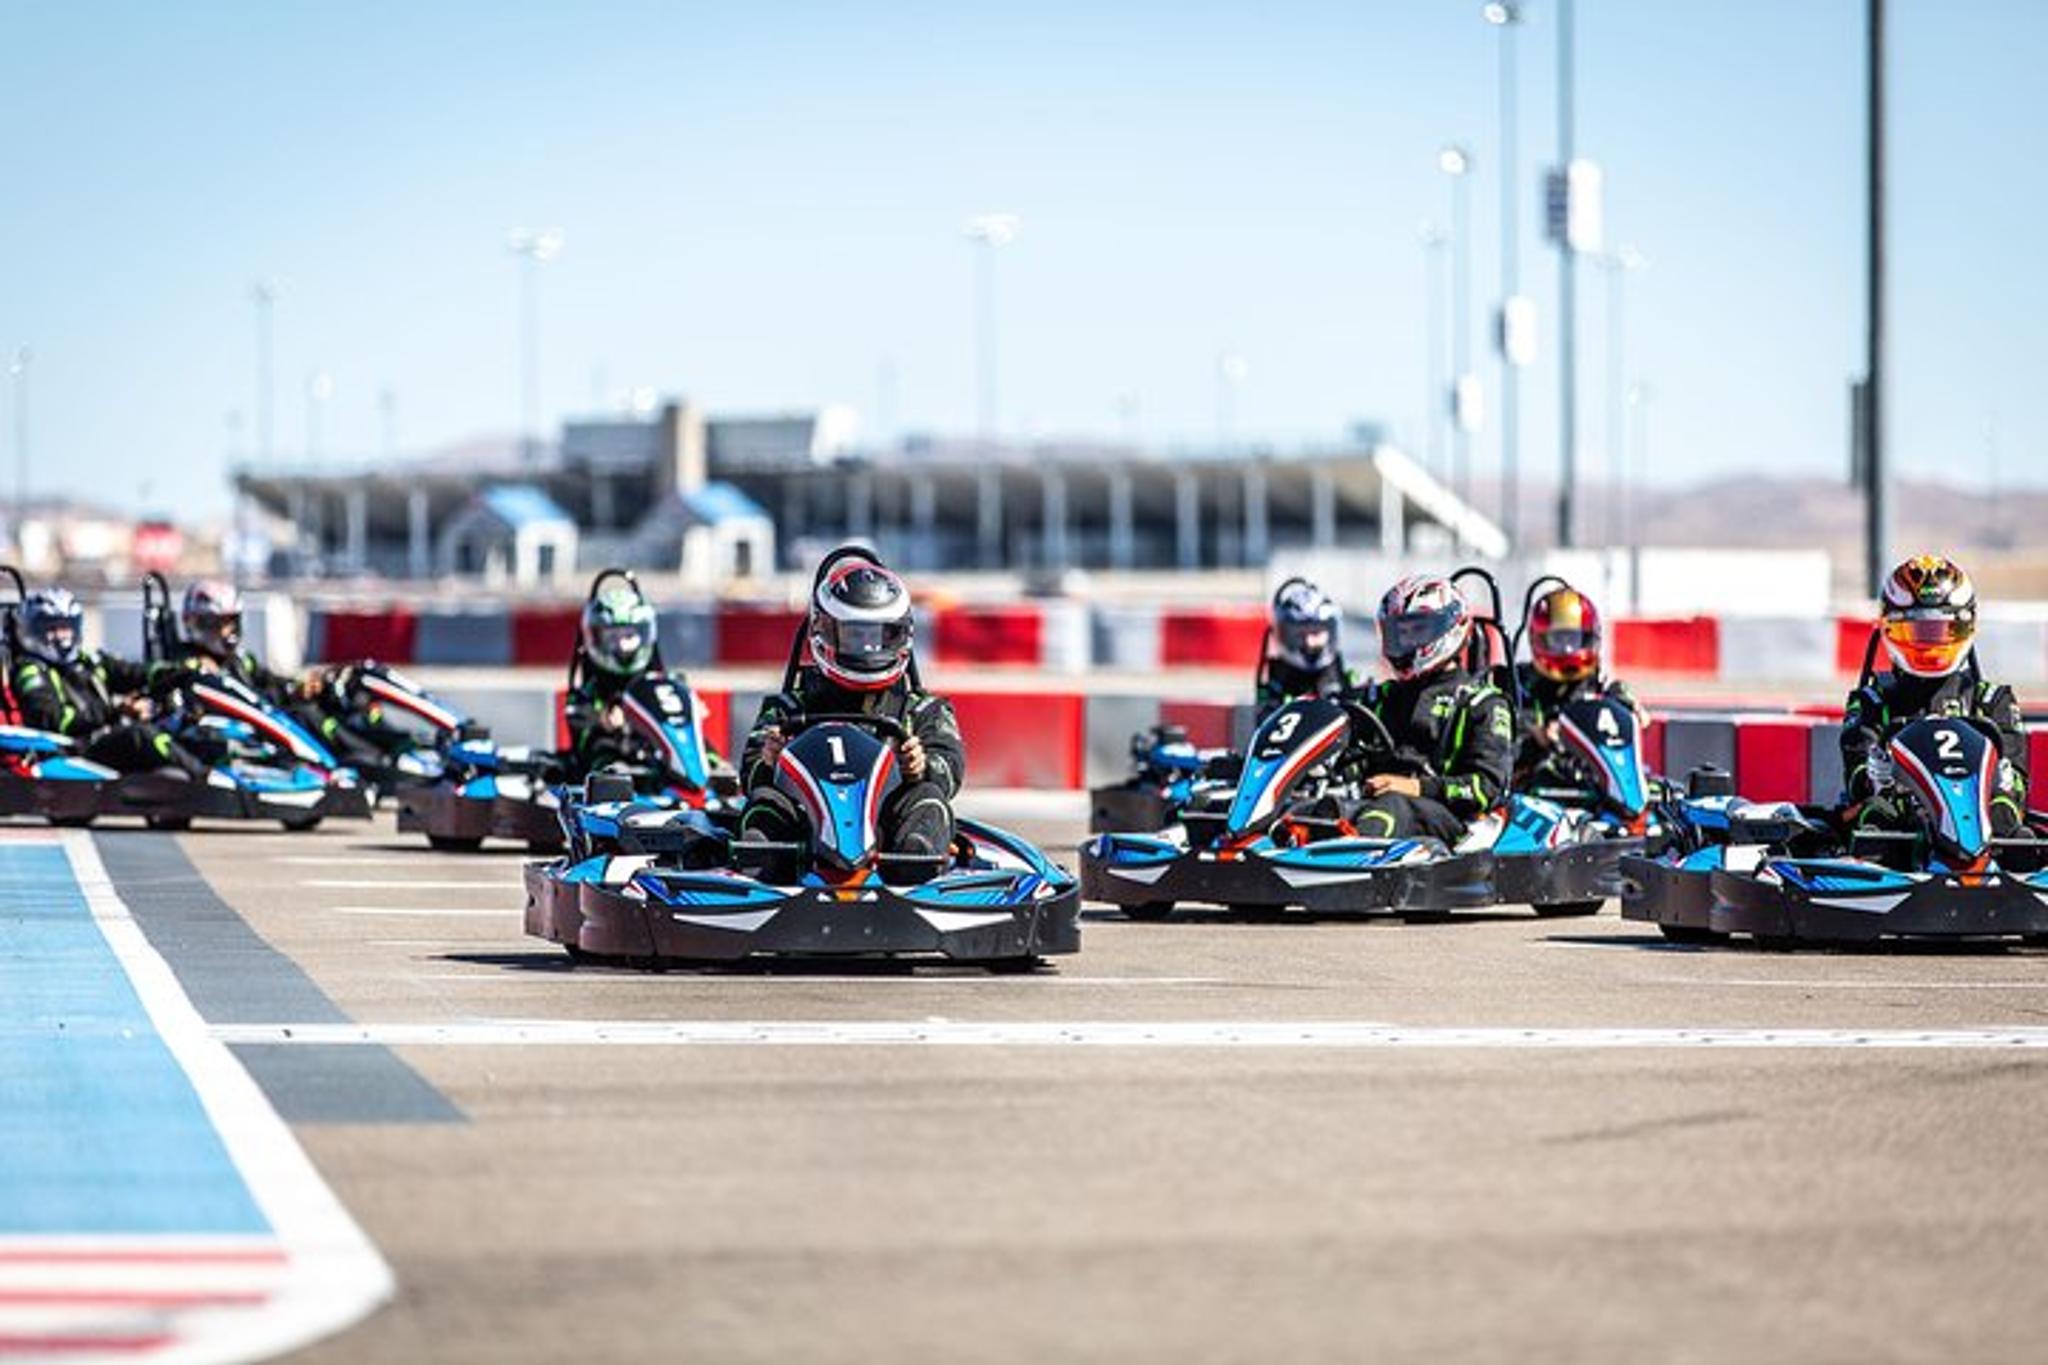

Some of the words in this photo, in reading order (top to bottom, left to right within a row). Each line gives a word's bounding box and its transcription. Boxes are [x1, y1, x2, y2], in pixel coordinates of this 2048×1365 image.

[655, 685, 683, 712] 5
[1269, 712, 1301, 742] 3
[1598, 708, 1619, 736] 4
[827, 736, 846, 764] 1
[1934, 730, 1964, 759] 2
